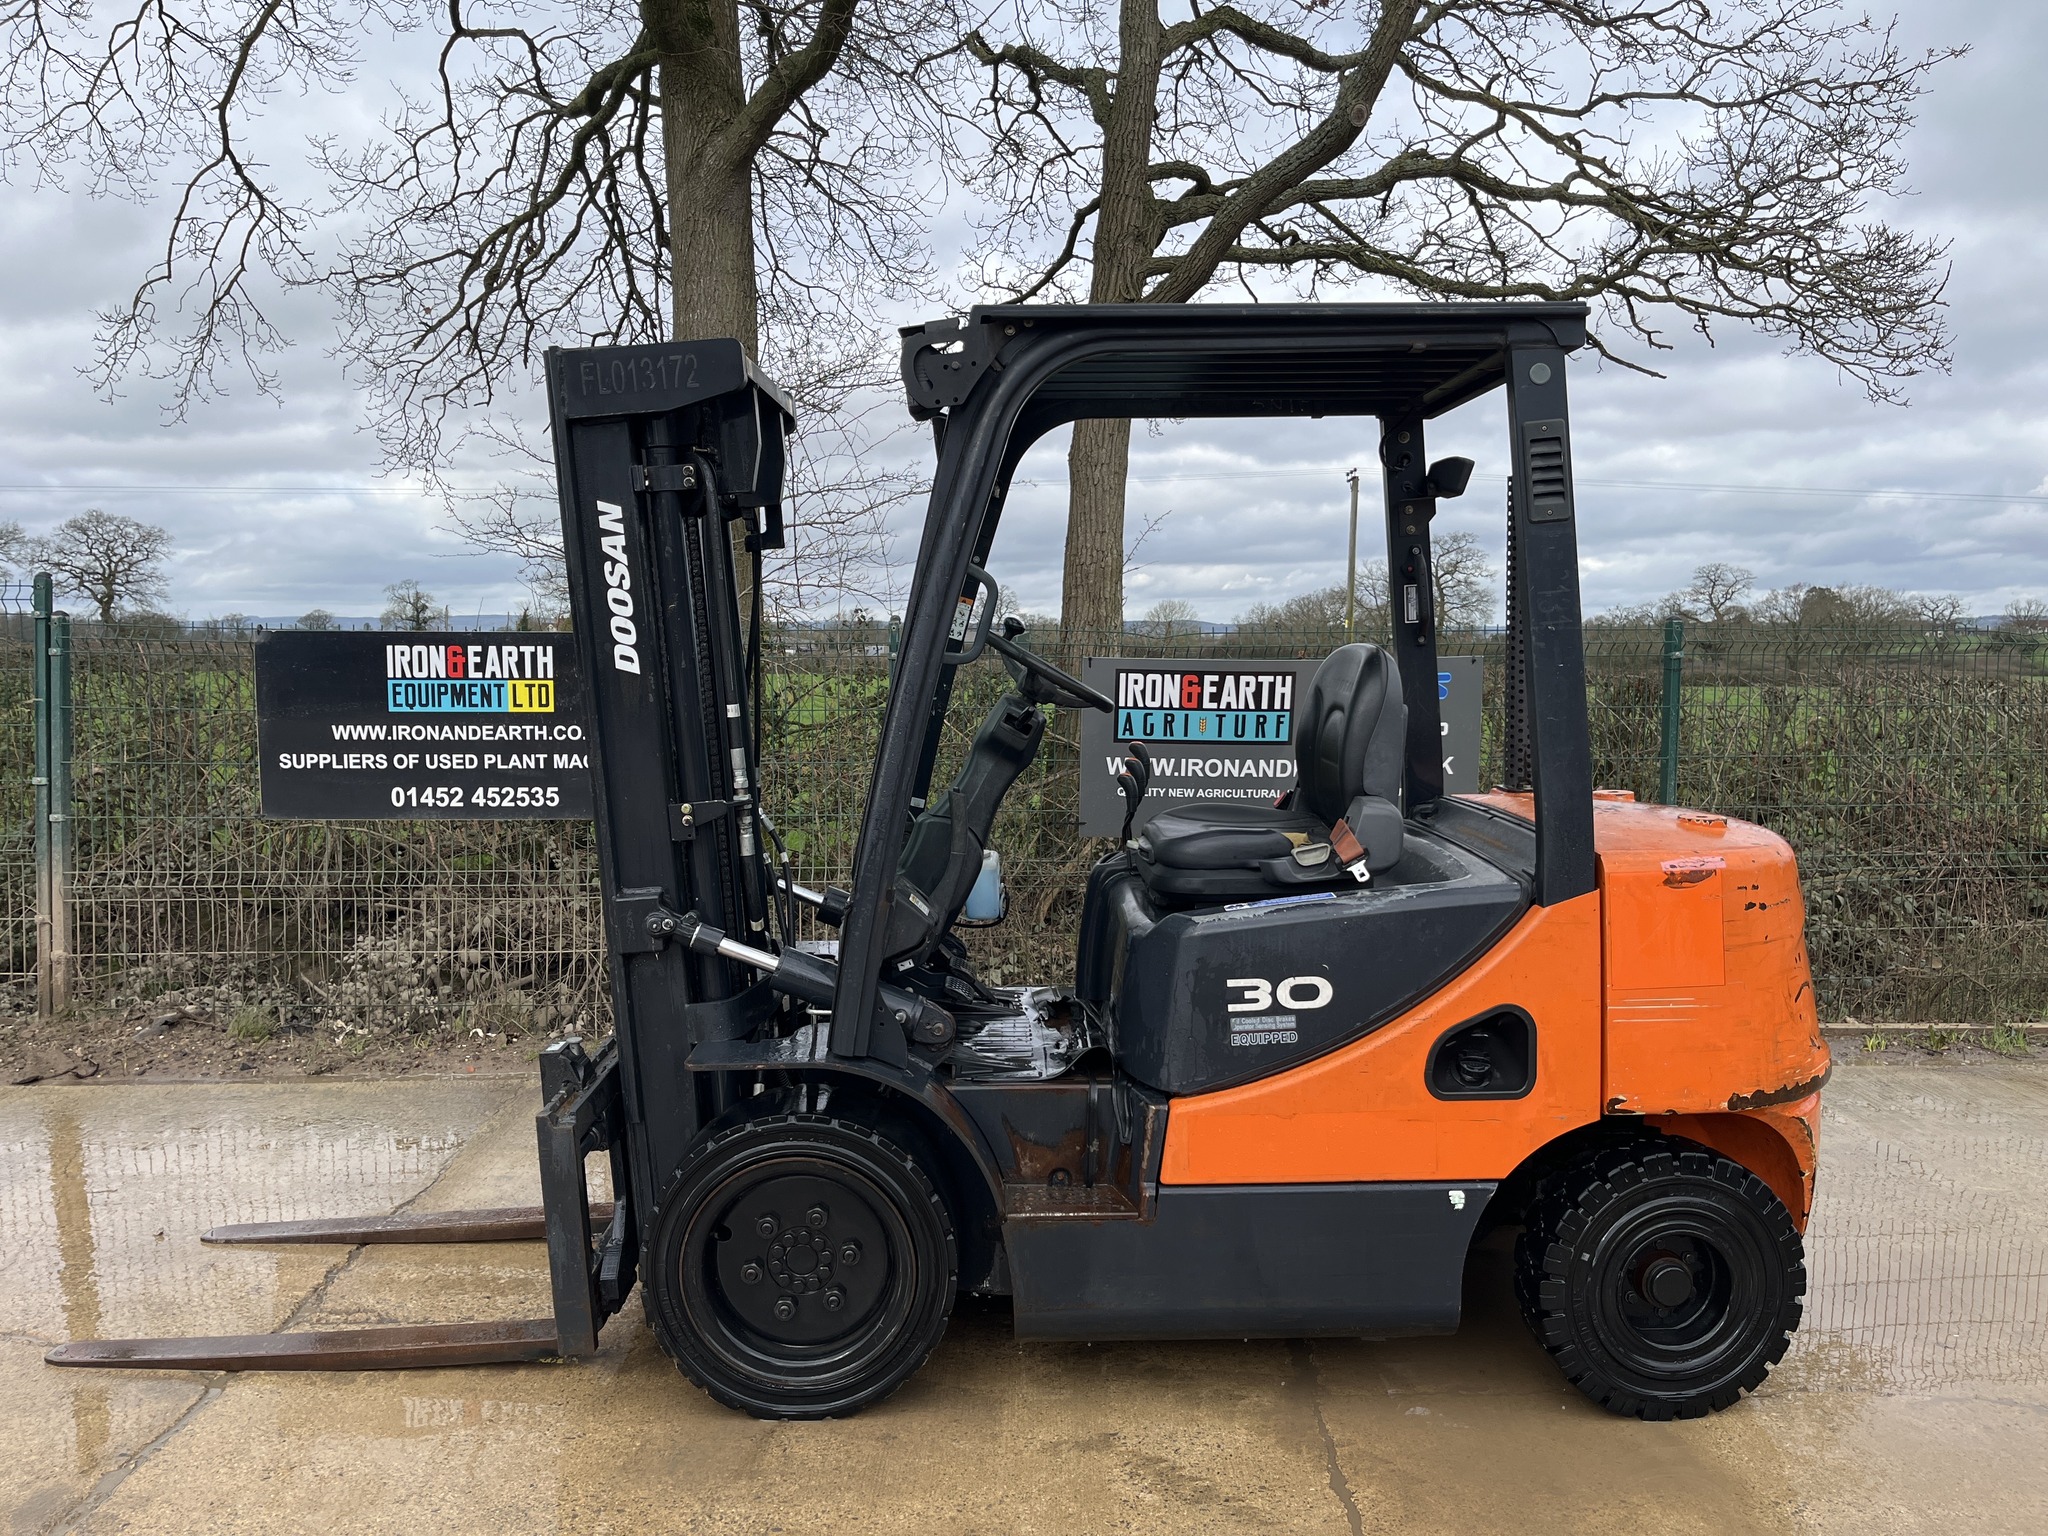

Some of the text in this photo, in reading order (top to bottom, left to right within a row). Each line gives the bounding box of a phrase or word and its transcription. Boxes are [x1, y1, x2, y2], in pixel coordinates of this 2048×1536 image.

[579, 352, 700, 396] FL013172
[597, 500, 641, 675] DOOSAN
[386, 645, 554, 679] IRON&EARTH
[392, 684, 550, 710] EQUIPMENT LTD
[1118, 672, 1292, 710] IRON&EARTH
[331, 724, 586, 741] WWW.IRONANDEARTH.CO.
[1122, 713, 1286, 739] AGRI TURF
[279, 753, 388, 770] SUPPLIERS
[393, 753, 420, 770] OF
[426, 753, 479, 770] USED
[484, 753, 548, 769] PLANT
[390, 786, 560, 808] 01452 452535
[1116, 786, 1166, 797] QITY
[1168, 788, 1195, 798] NEW
[1197, 788, 1281, 799] AGRICULTURAL
[1226, 976, 1333, 1012] 30
[1231, 1031, 1298, 1046] EQUIPPED
